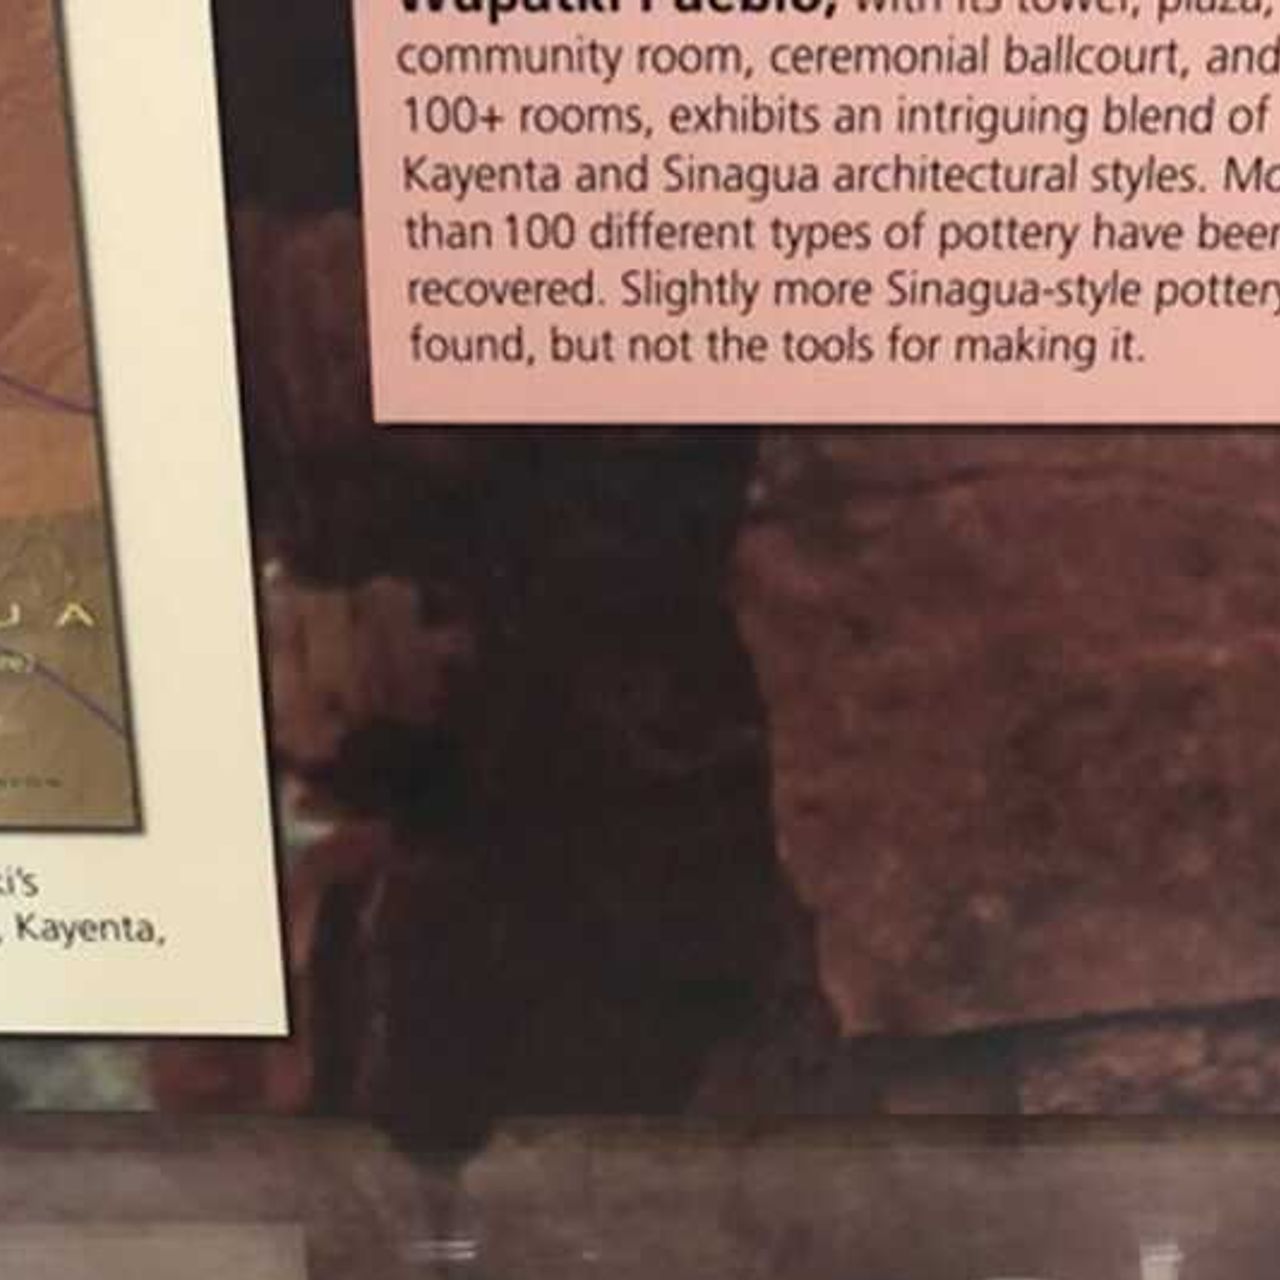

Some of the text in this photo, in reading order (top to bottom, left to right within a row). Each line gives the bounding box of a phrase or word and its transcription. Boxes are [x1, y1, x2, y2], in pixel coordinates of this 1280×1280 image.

[397, 40, 622, 84] community
[638, 45, 753, 79] room,
[770, 35, 988, 74] ceremonial
[1005, 35, 1188, 78] ballcourt,
[405, 94, 1270, 144] 100+ rooms, exhibits an intriguing blend of
[404, 156, 560, 201] Kayenta
[576, 154, 648, 192] and
[664, 154, 818, 202] Sinagua
[833, 154, 1077, 192] architectural
[1092, 155, 1205, 202] styles.
[406, 212, 492, 249] than
[506, 213, 575, 249] 100
[590, 211, 754, 250] different
[771, 218, 871, 259] types
[885, 211, 925, 249] of
[939, 218, 1079, 259] pottery
[1094, 213, 1183, 250] have
[409, 270, 604, 307] recovered.
[622, 269, 759, 316] Slightly
[774, 279, 872, 307] more
[888, 270, 1141, 316] Sinagua-style
[16, 914, 165, 948] Kayenta,
